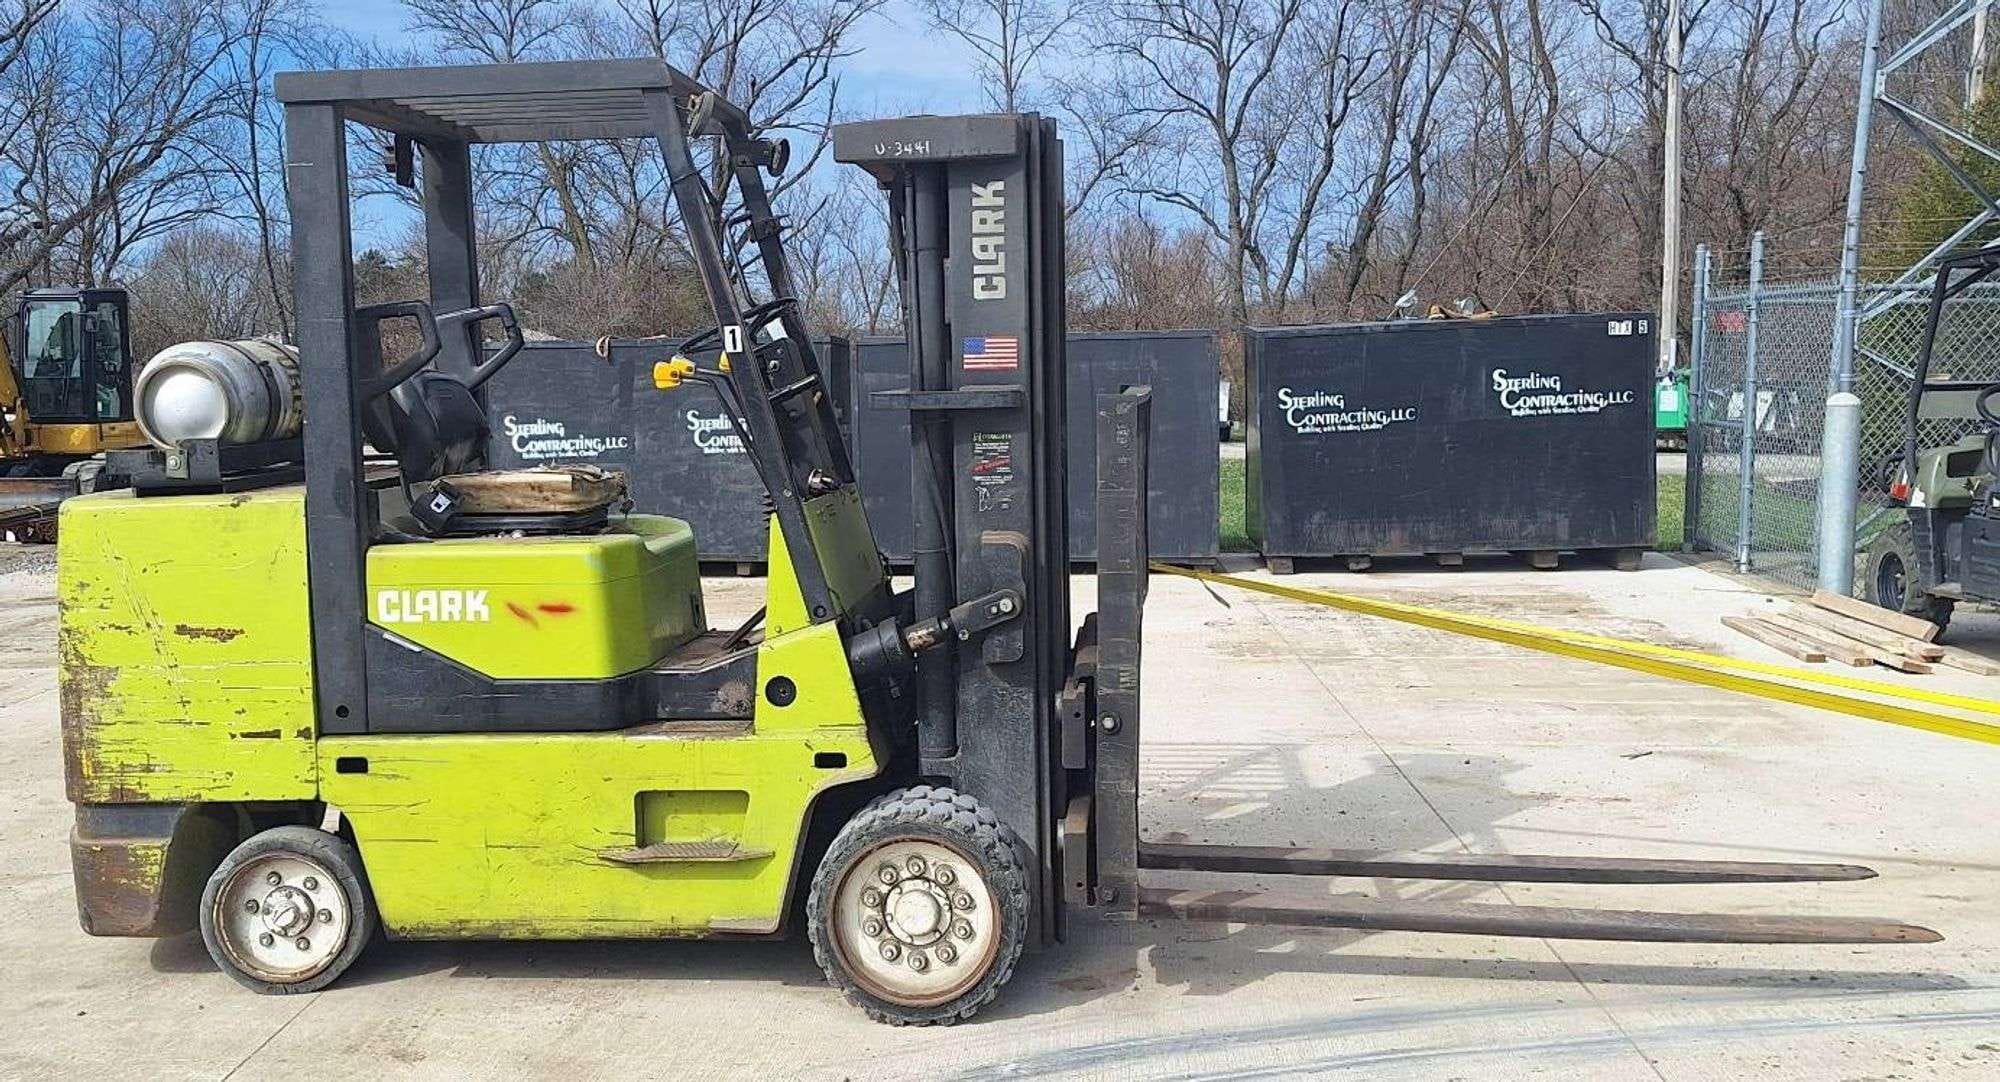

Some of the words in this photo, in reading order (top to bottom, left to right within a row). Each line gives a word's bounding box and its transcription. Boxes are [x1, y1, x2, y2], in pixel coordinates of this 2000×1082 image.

[971, 180, 1006, 300] CLARK
[1608, 390, 1635, 404] LLC
[1391, 407, 1417, 421] LLC
[605, 436, 629, 449] LLC
[377, 590, 490, 623] CLARK
